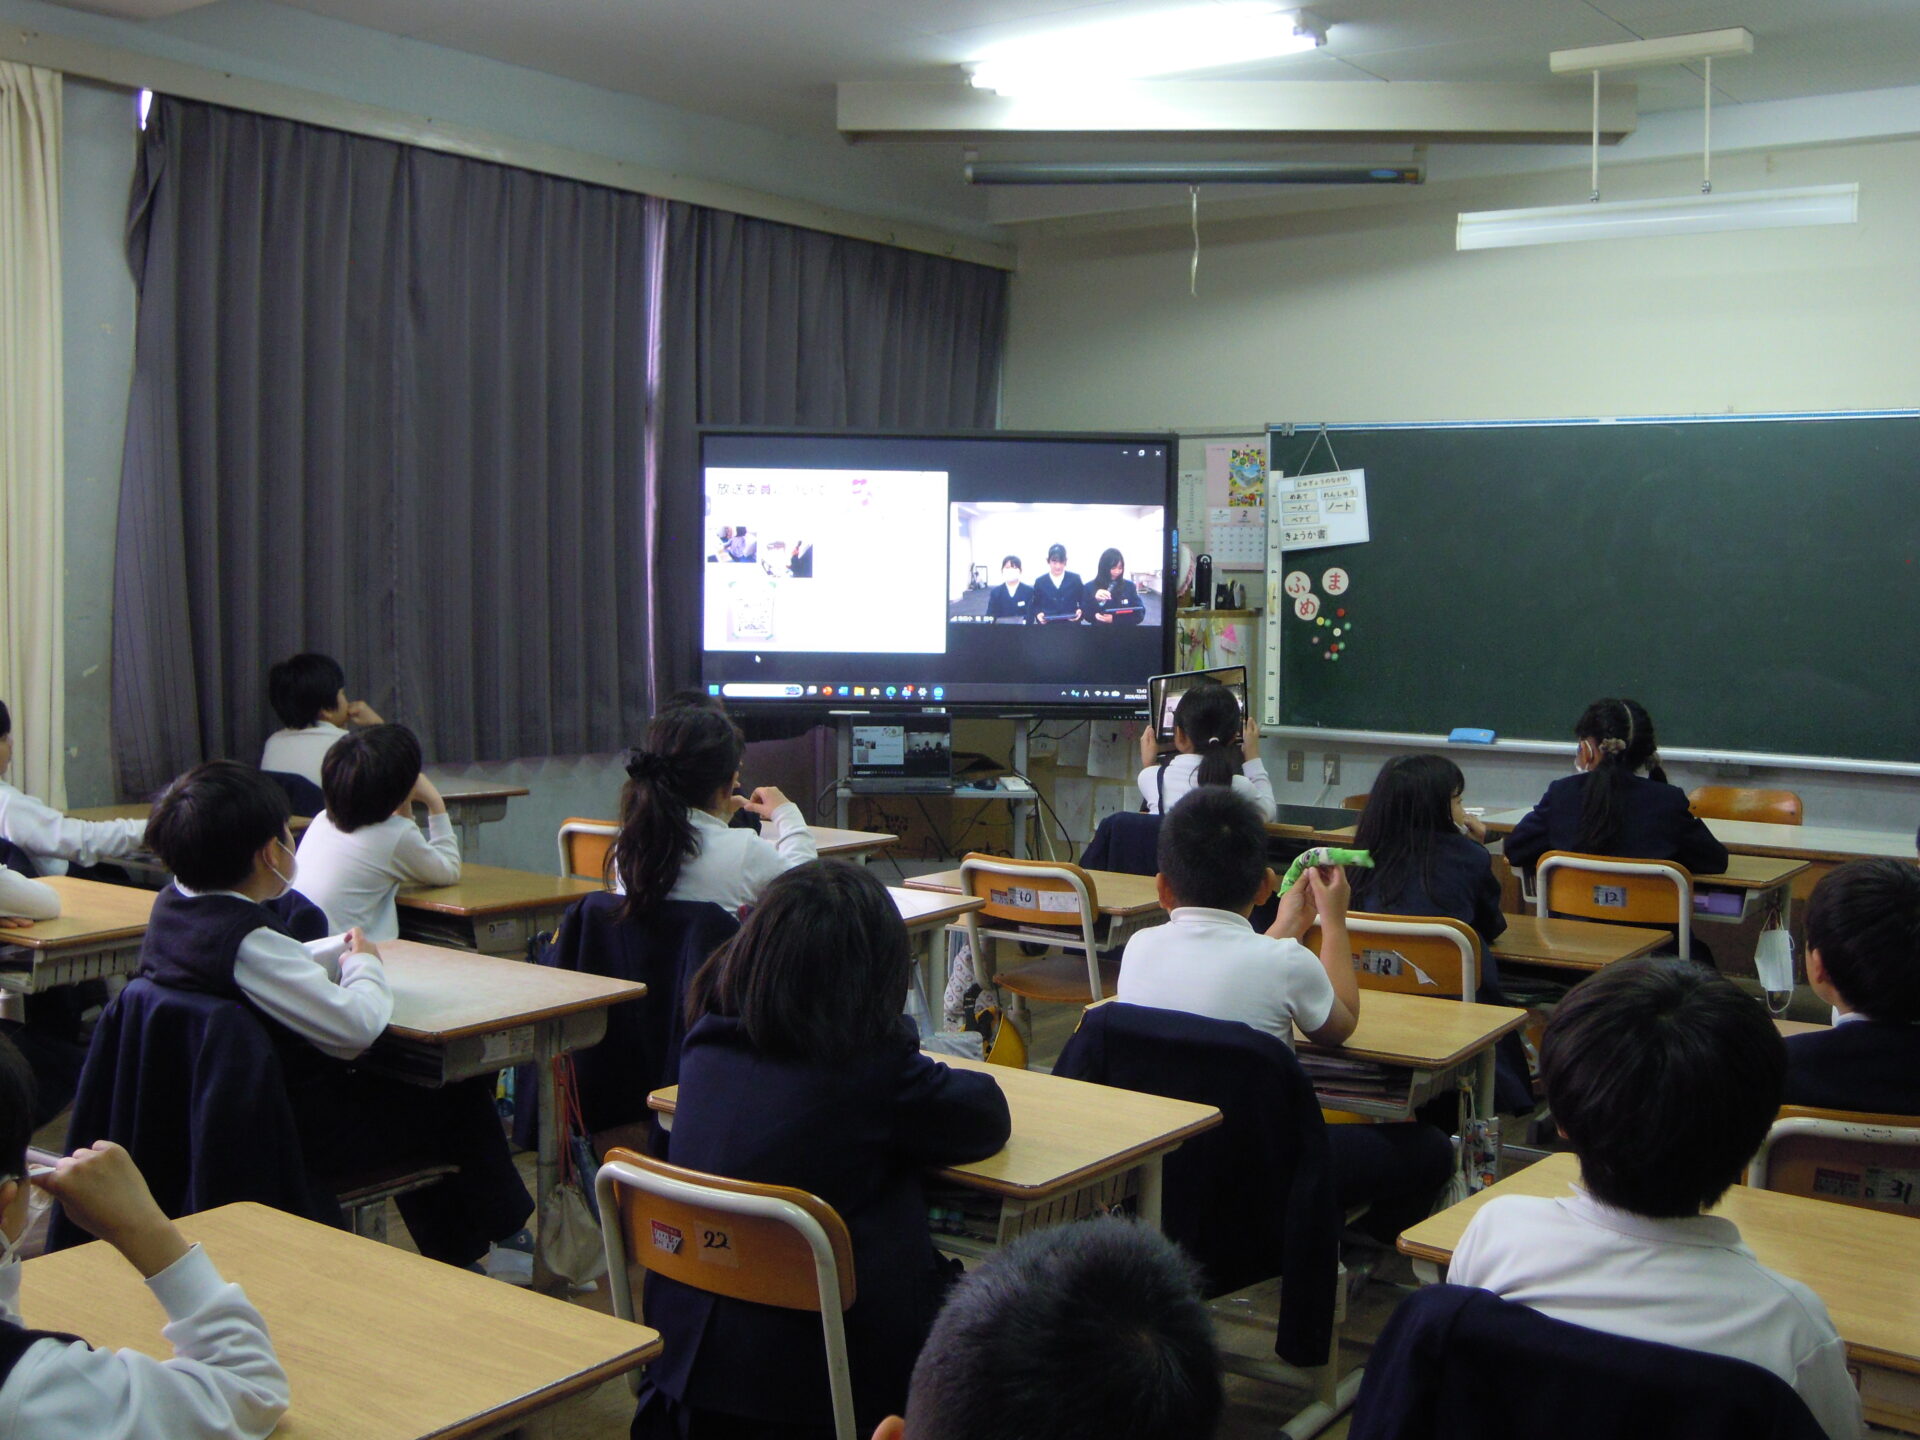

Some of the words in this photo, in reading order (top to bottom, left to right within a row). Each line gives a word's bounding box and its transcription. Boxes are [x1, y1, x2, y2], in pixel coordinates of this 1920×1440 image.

[1323, 489, 1355, 498] れんしゅう
[1328, 501, 1351, 511] ノート
[1285, 529, 1326, 541] きょうか書
[1288, 576, 1306, 593] ふ
[1328, 573, 1341, 590] ま
[1300, 598, 1316, 616] め
[1019, 890, 1032, 903] 10
[1887, 1178, 1913, 1205] 31
[703, 1230, 731, 1250] 22
